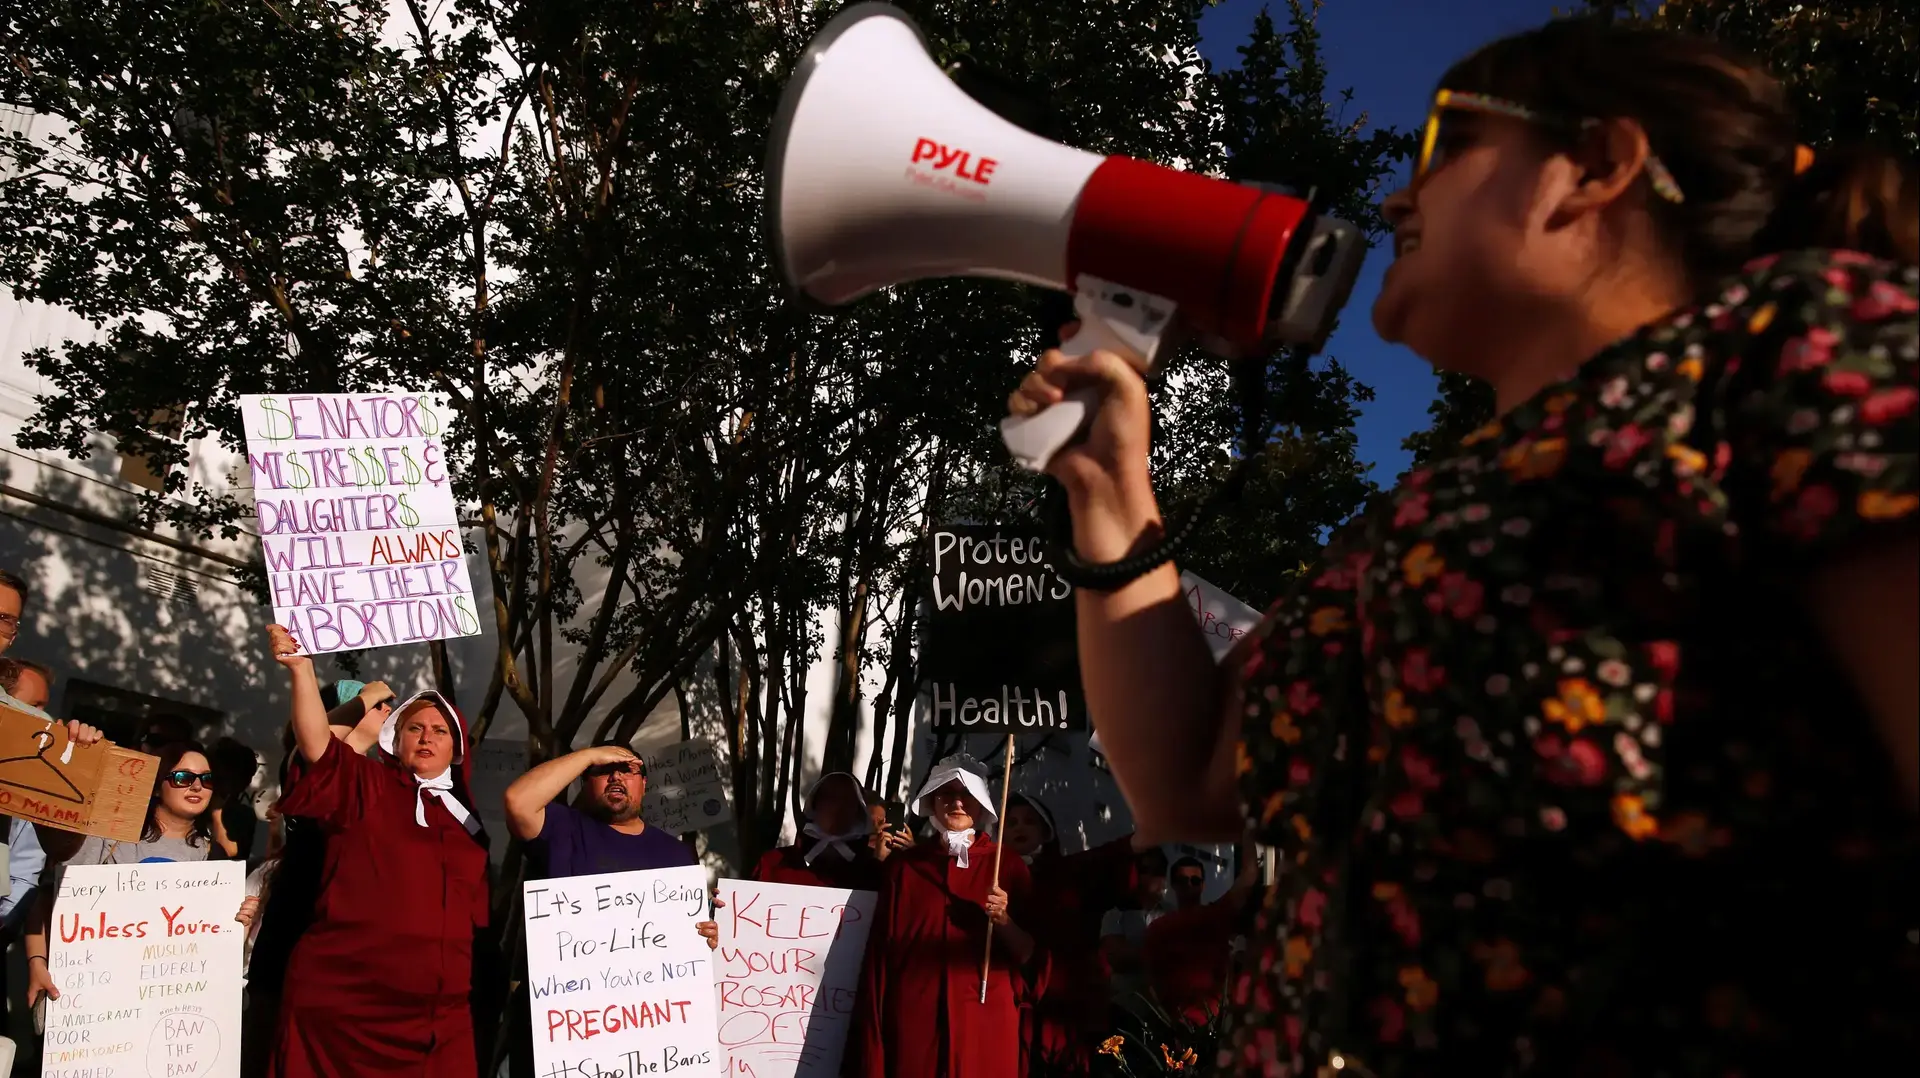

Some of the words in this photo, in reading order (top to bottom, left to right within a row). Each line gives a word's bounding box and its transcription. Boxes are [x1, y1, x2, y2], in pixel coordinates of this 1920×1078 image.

[911, 136, 999, 186] PYLE
[263, 536, 363, 572] WILL
[370, 529, 461, 565] ALWAYS
[934, 531, 1044, 574] Protec
[271, 571, 354, 607] HAVE
[357, 560, 464, 600] THEIR
[1186, 584, 1247, 641] ABOR
[933, 682, 1068, 729] Health!
[57, 876, 107, 911] Every
[117, 869, 146, 892] life
[175, 871, 231, 889] sacred...
[527, 888, 582, 920] It's
[595, 884, 646, 918] Easy
[652, 879, 703, 917] Being
[60, 911, 149, 944] Unless
[160, 905, 232, 938] You're...
[732, 891, 862, 940] KEEP
[54, 950, 93, 969] Black
[142, 942, 199, 961] MUSLIM
[556, 921, 668, 962] Pro-Life
[140, 959, 207, 980] ELDERLY
[531, 975, 591, 1000] When
[599, 967, 655, 988] You're
[662, 959, 706, 982] NOT
[721, 946, 816, 978] YOUR
[139, 980, 208, 1001] VETERAN
[47, 1008, 142, 1028] IMMIGRANT
[164, 1018, 205, 1041] BAN
[547, 999, 692, 1042] PREGNANT
[718, 1010, 838, 1046] OFF
[45, 1041, 134, 1065] IMPRISONED
[46, 1030, 91, 1047] POOR
[165, 1043, 195, 1058] THE
[167, 1060, 198, 1078] BAN
